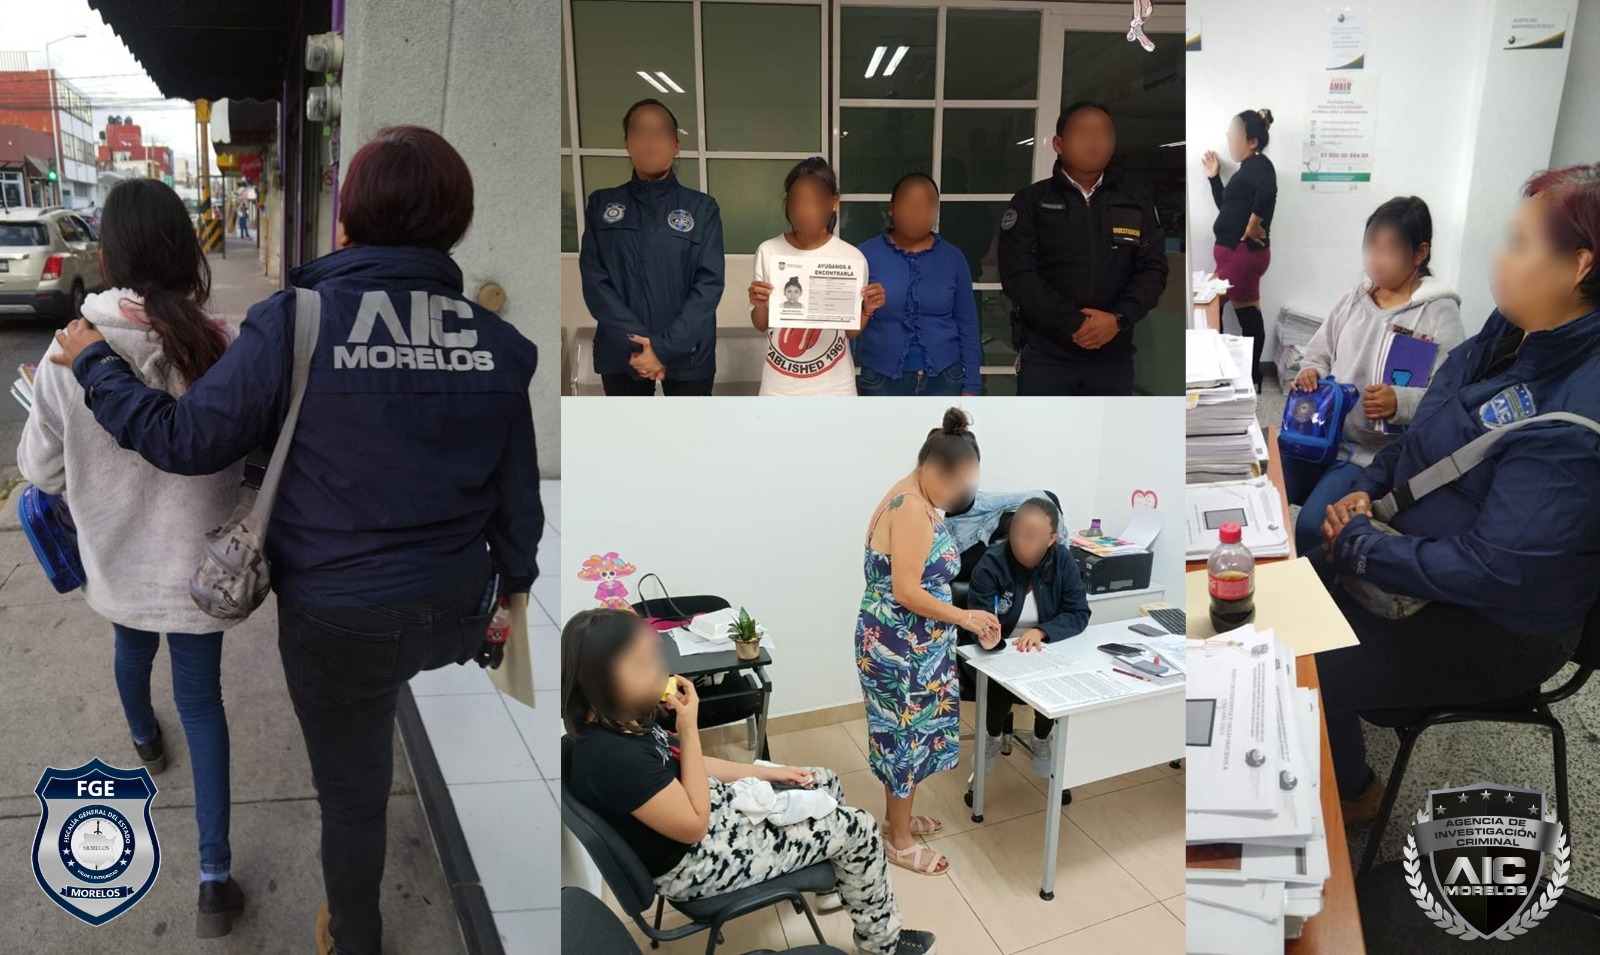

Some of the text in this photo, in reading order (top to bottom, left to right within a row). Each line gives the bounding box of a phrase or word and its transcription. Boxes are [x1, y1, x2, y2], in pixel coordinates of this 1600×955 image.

[1330, 82, 1352, 91] AMBER
[348, 291, 478, 348] AIC
[334, 346, 494, 371] MORELOS
[826, 336, 845, 362] 1962
[1357, 555, 1367, 575] FGE
